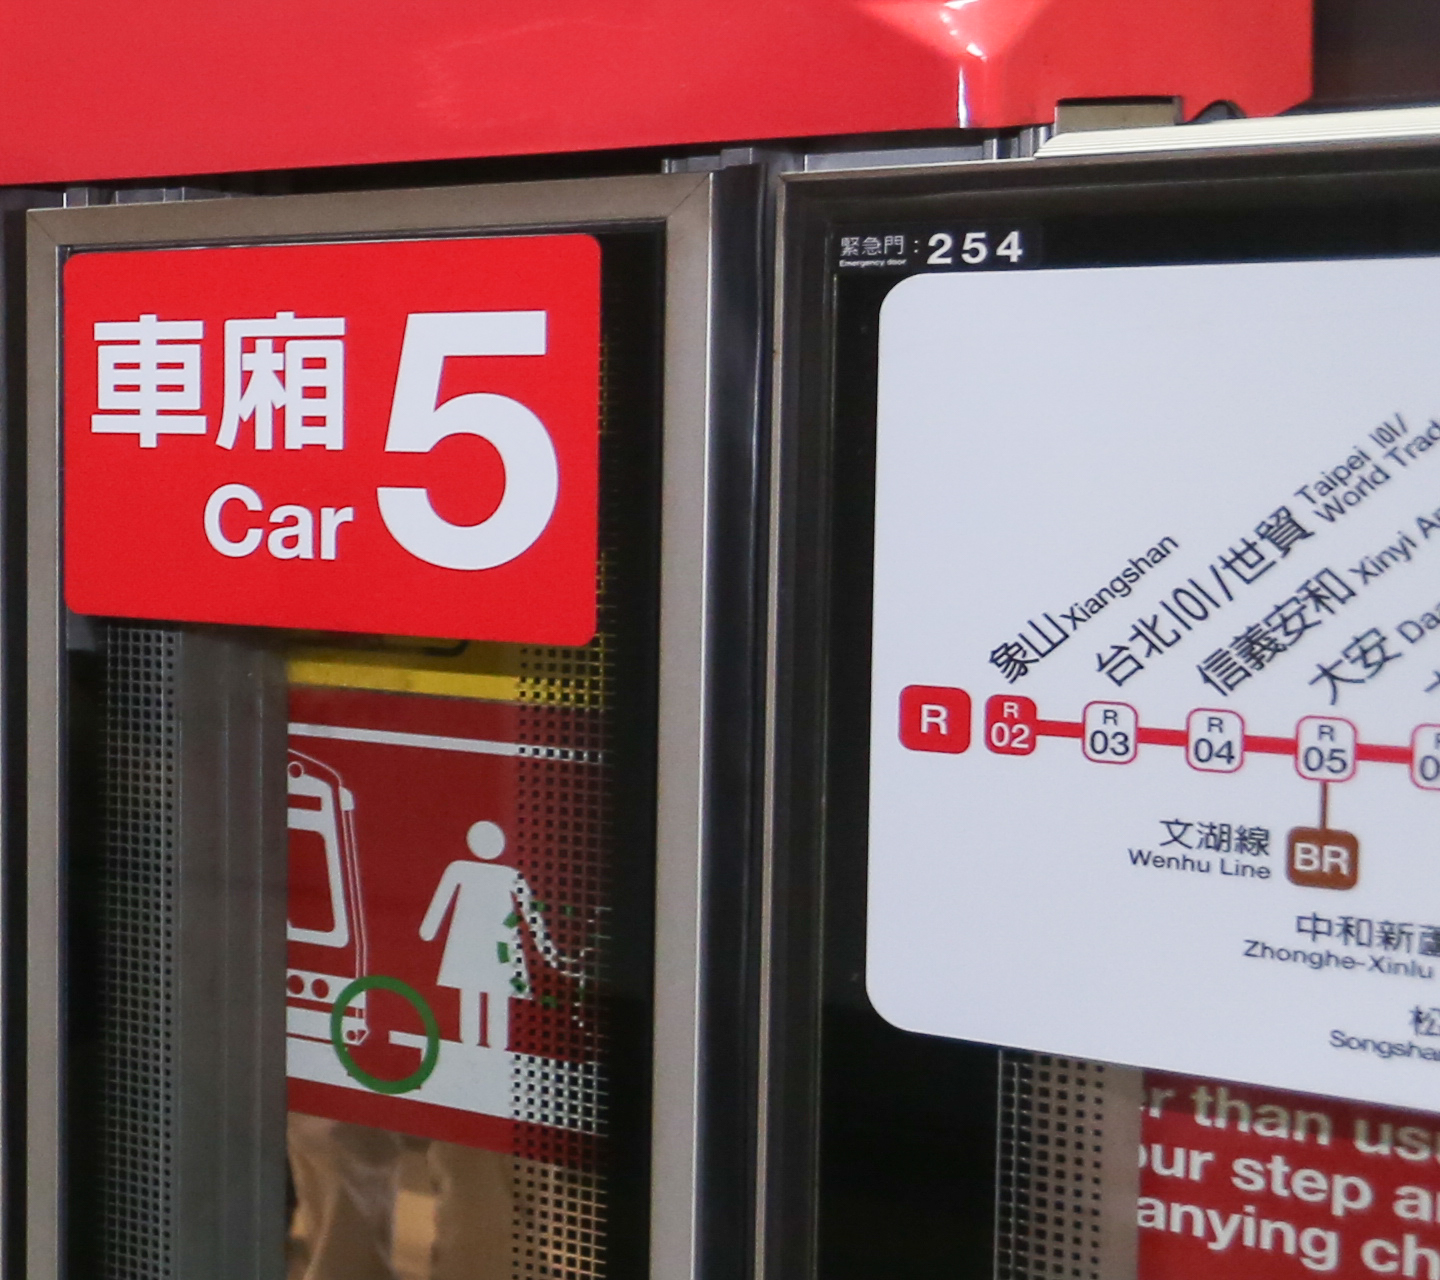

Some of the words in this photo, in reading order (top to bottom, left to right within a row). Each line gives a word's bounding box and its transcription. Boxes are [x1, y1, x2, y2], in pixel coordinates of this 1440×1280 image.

[839, 259, 885, 268] Emergency
[886, 258, 907, 266] door
[926, 230, 1024, 265] 254
[91, 312, 347, 453] 車廂
[376, 310, 559, 572] 5
[1293, 444, 1372, 505] Taipei
[1312, 463, 1391, 523] World
[203, 483, 354, 561] Car
[988, 612, 1070, 684] 象山
[1059, 535, 1180, 632] Xiangshan
[1196, 567, 1358, 698] 信義安和
[1348, 530, 1418, 586] Xinyi
[1308, 627, 1404, 706] 大安
[919, 703, 948, 735] R
[1002, 701, 1019, 718] R
[1102, 708, 1119, 726] R
[1207, 716, 1224, 734] R
[990, 721, 1030, 749] 02
[1089, 729, 1130, 757] 03
[1193, 737, 1236, 765] 04
[1317, 724, 1335, 742] R
[1303, 745, 1348, 774] 05
[1158, 817, 1271, 858] 文湖線
[1128, 847, 1211, 874] Wenhu
[1219, 857, 1271, 880] Line
[1293, 841, 1351, 877] BR
[1242, 938, 1434, 980] Zhonghe-Xinlu
[1190, 1085, 1331, 1146] than
[1352, 1118, 1440, 1163] us
[1231, 1154, 1373, 1217] step
[1392, 1184, 1440, 1223] a
[1136, 1195, 1340, 1271] anying
